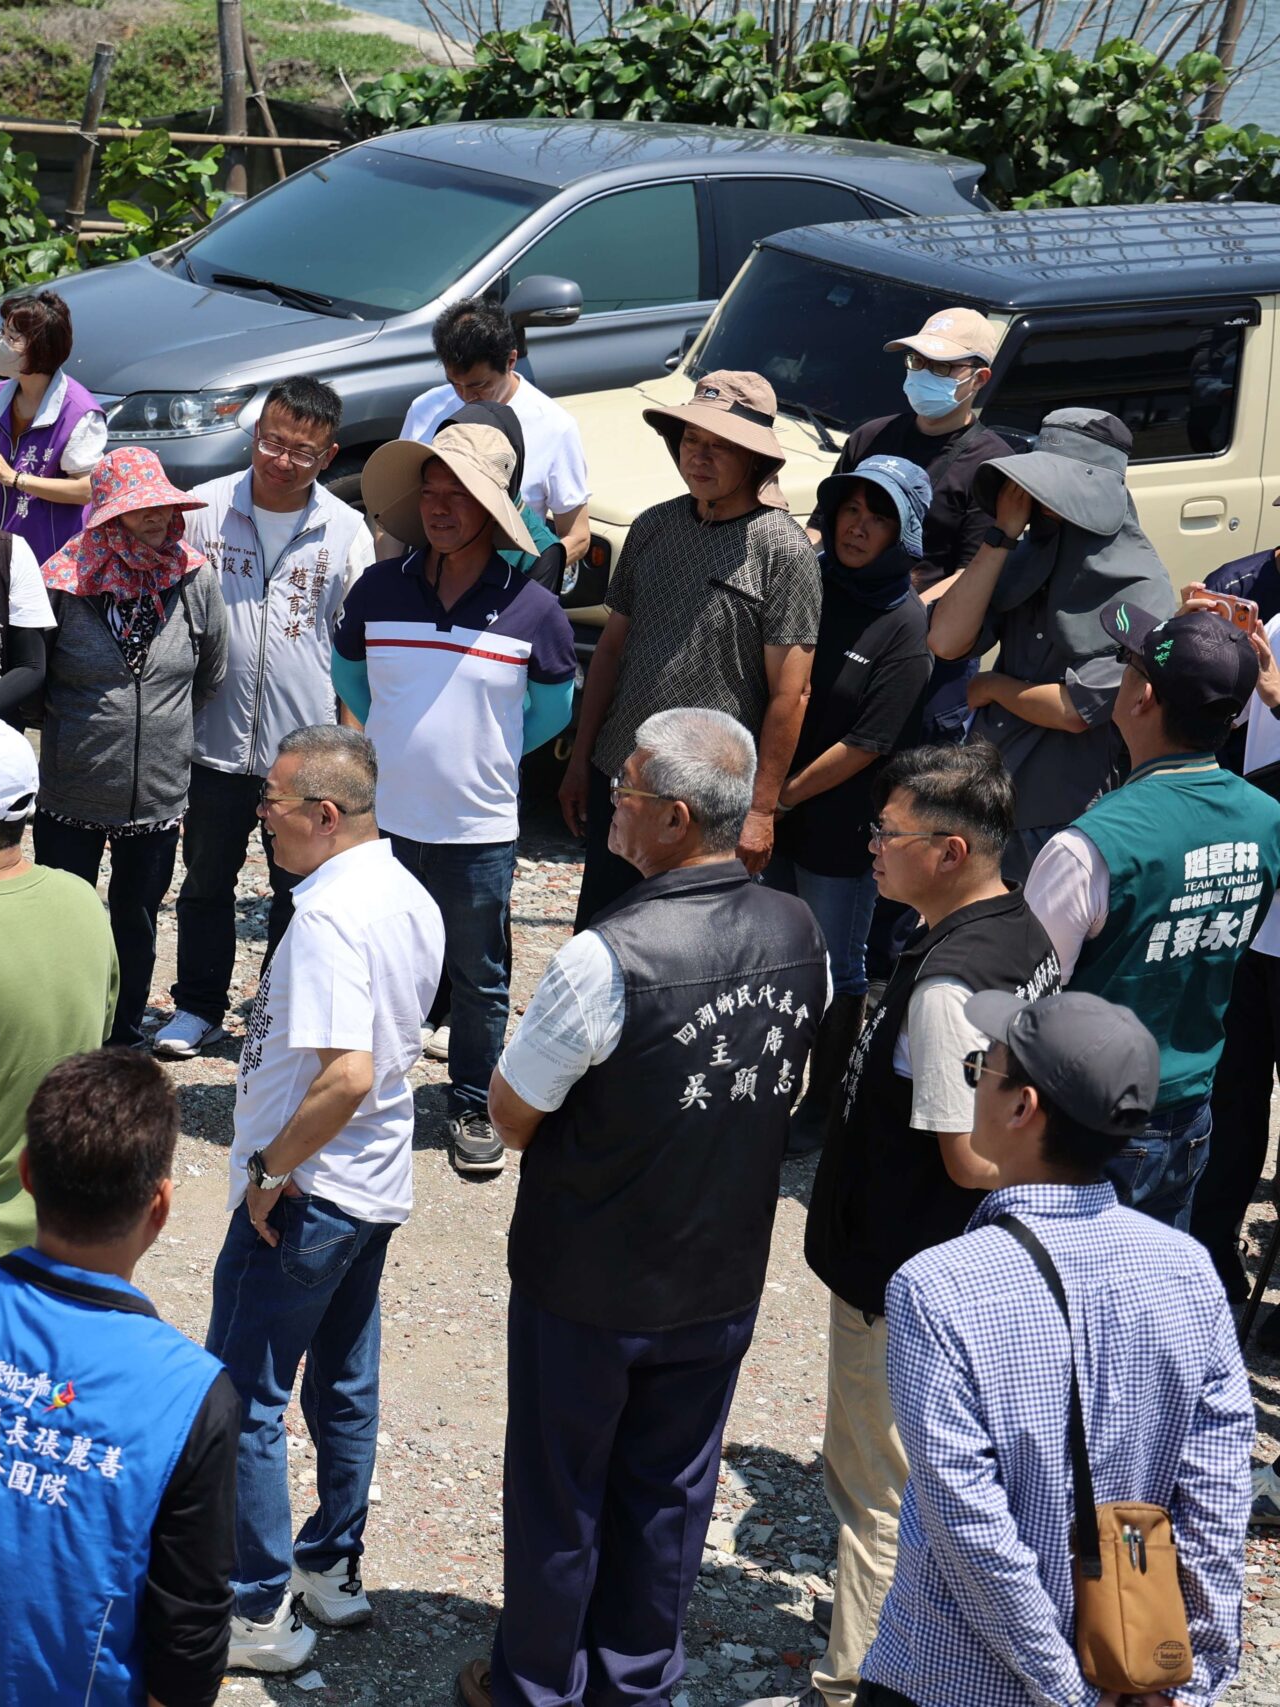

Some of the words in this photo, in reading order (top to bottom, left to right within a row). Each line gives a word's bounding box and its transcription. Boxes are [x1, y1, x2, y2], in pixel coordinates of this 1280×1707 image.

[1184, 878, 1214, 893] TEAM
[1216, 872, 1258, 888] YUNLIN
[673, 984, 809, 1046] 四湖鄉民代表會
[709, 1025, 786, 1068] 主席
[678, 1058, 797, 1111] 吳顯志
